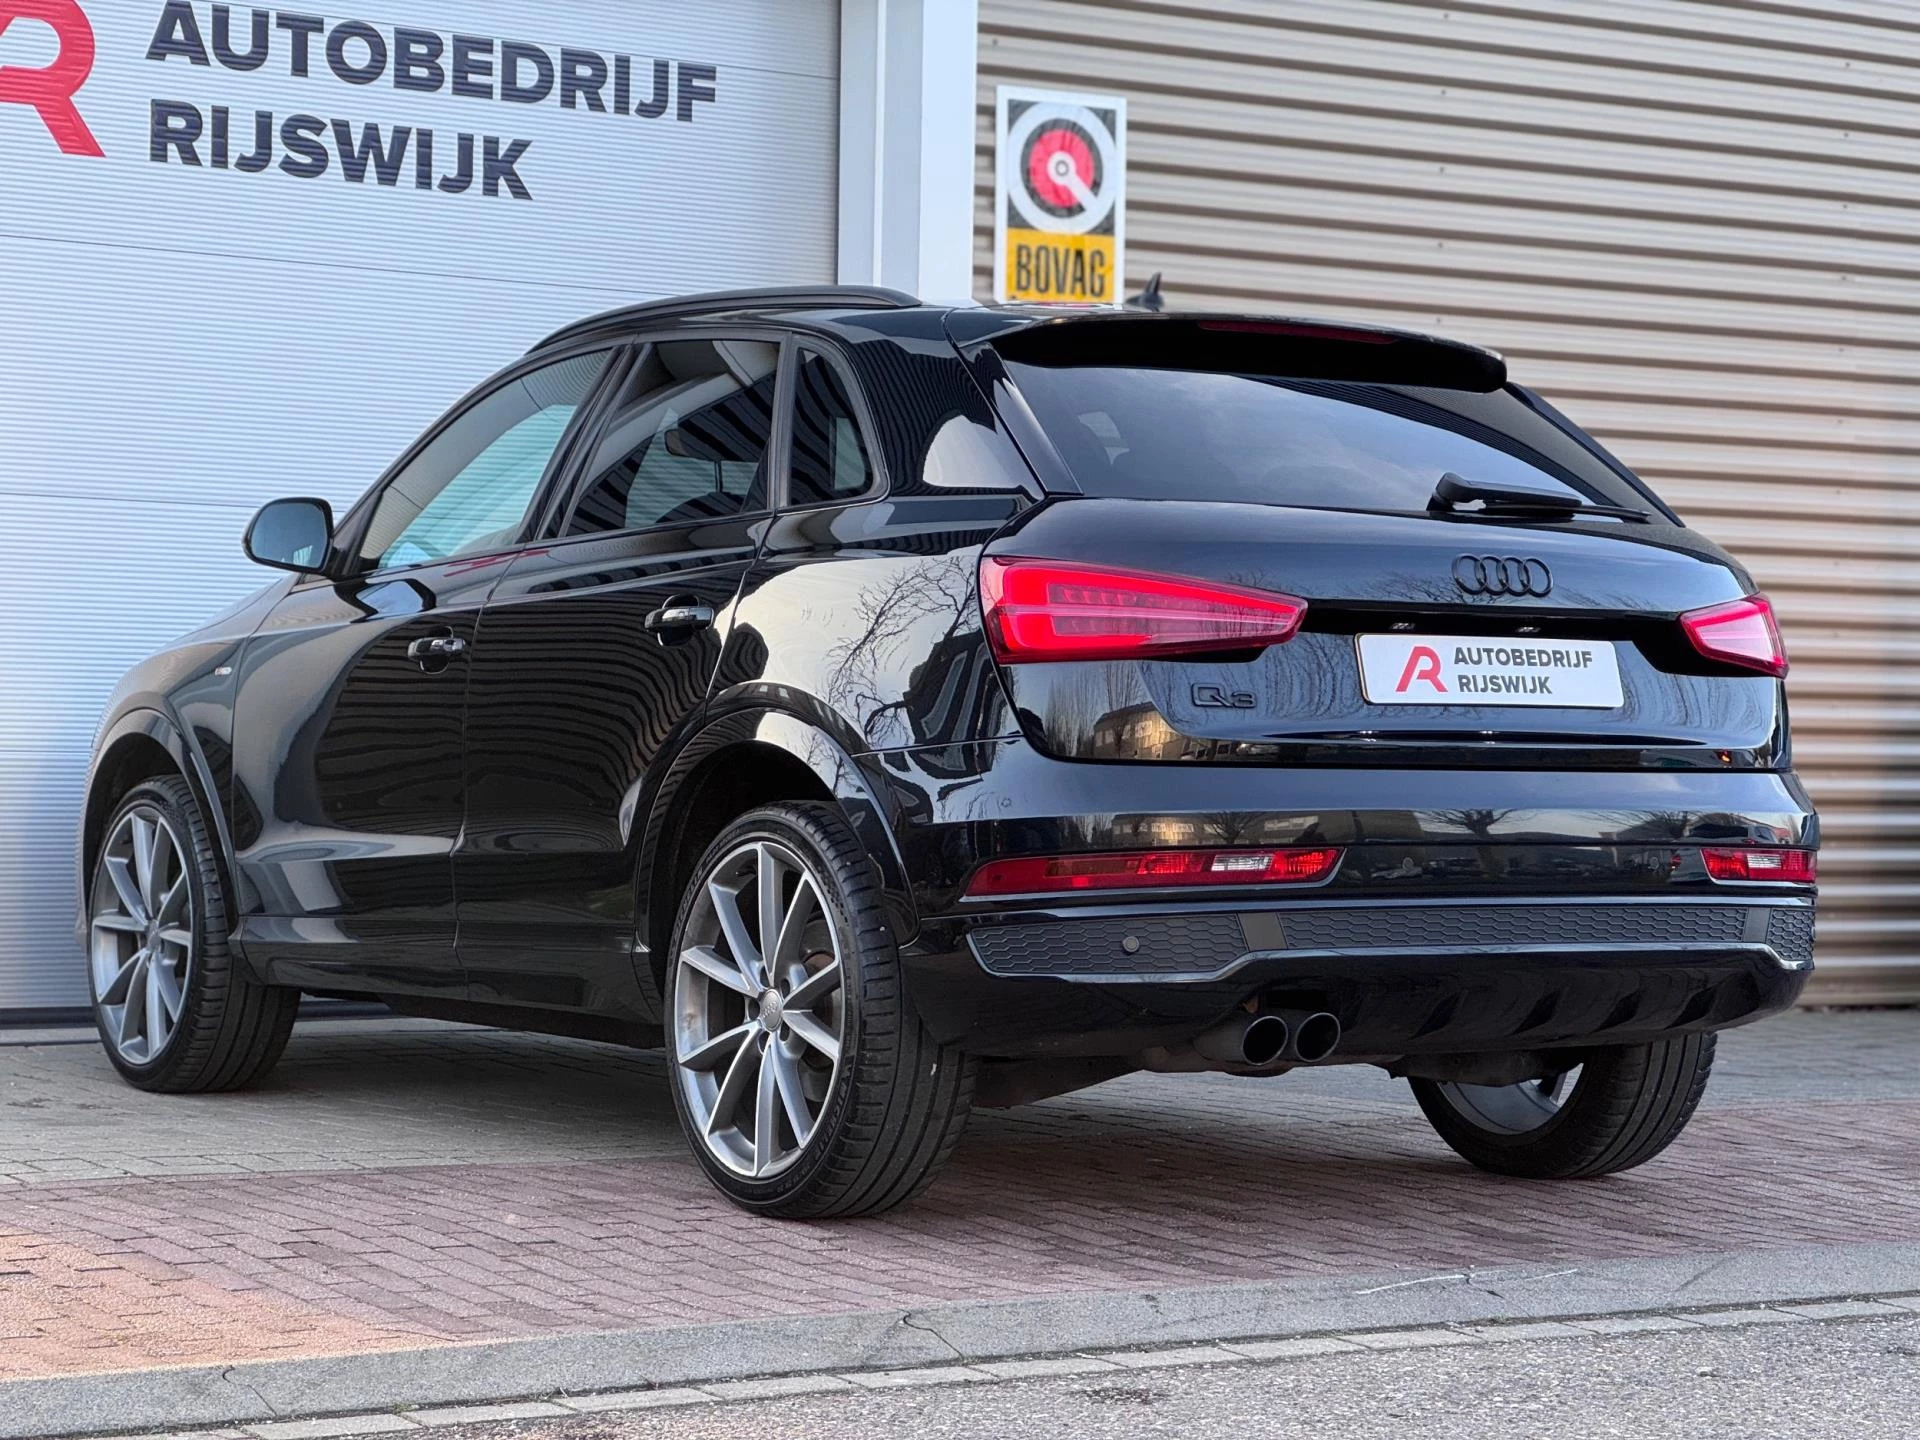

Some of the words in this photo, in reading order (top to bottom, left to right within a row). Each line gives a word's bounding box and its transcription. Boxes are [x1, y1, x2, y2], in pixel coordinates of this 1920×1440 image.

[146, 0, 716, 122] AUTOBEDRIJF
[150, 99, 534, 201] RIJSWIJK
[1016, 244, 1105, 297] BOVAG
[1454, 647, 1593, 668] AUTOBEDRIJF
[1191, 683, 1257, 708] Q3
[1457, 675, 1552, 694] RIJSWIJK
